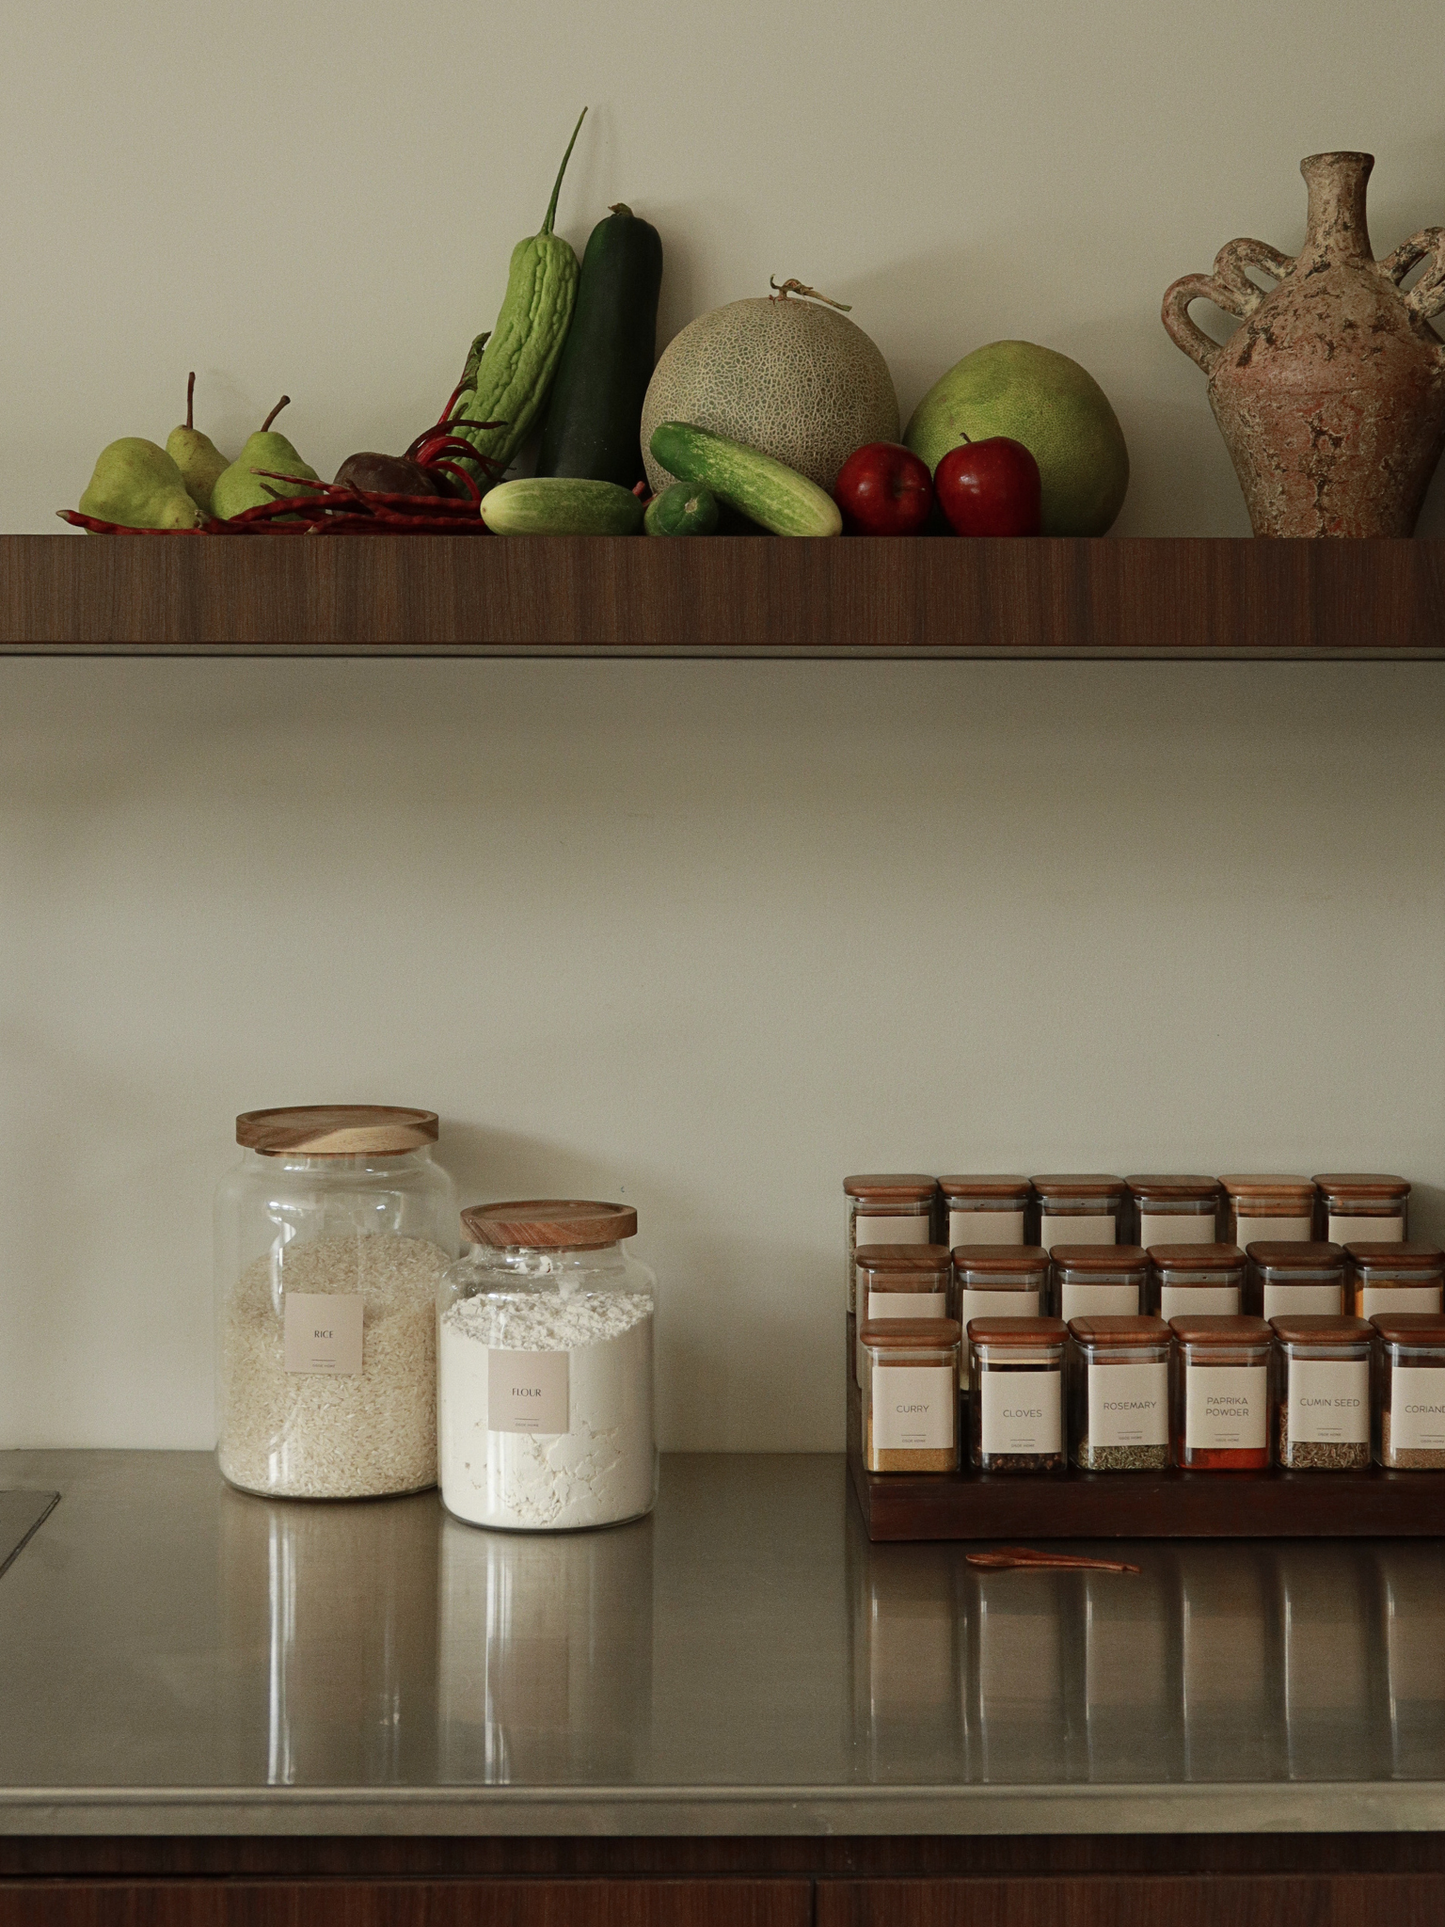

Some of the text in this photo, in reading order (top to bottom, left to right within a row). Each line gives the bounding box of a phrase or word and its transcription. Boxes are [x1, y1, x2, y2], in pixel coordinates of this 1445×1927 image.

[314, 1330, 334, 1339] RICE
[512, 1387, 542, 1397] FLOUR
[1206, 1397, 1248, 1405] PAPRIKA
[1300, 1398, 1361, 1407] CUMIN SEED
[896, 1405, 930, 1414] CURRY
[1103, 1401, 1157, 1411] ROSEMARY
[1003, 1409, 1043, 1418] CLOVES
[1206, 1408, 1249, 1416] POWDER
